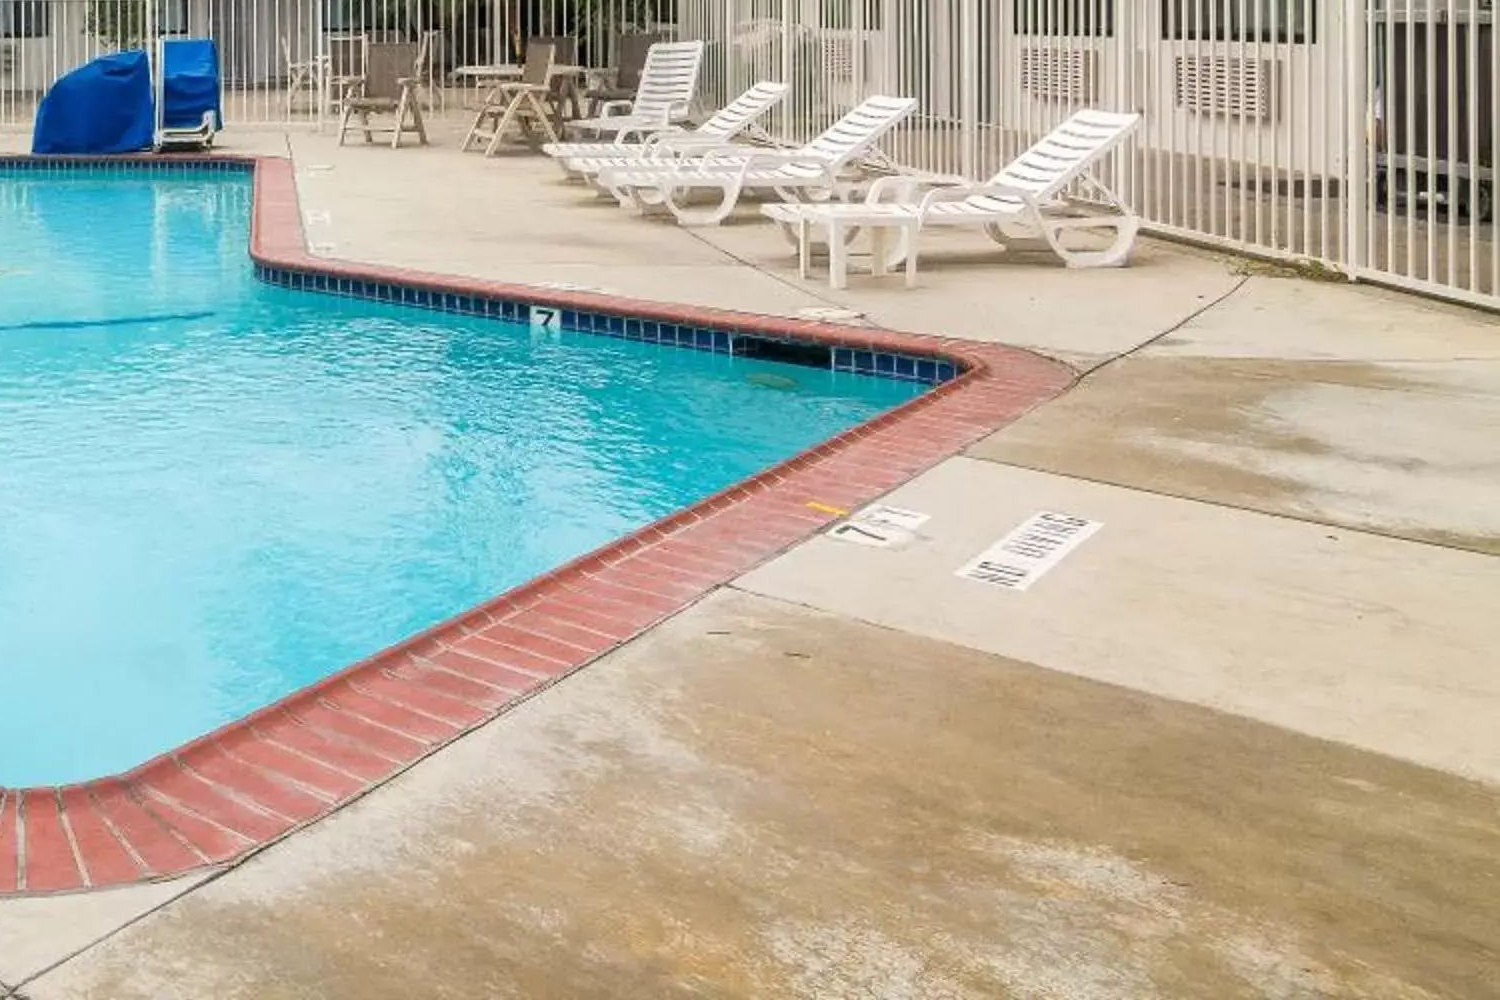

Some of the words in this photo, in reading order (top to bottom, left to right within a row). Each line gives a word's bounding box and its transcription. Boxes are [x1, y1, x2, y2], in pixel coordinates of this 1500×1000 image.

[536, 309, 555, 326] 7
[835, 524, 887, 541] 7
[966, 561, 1027, 587] NO
